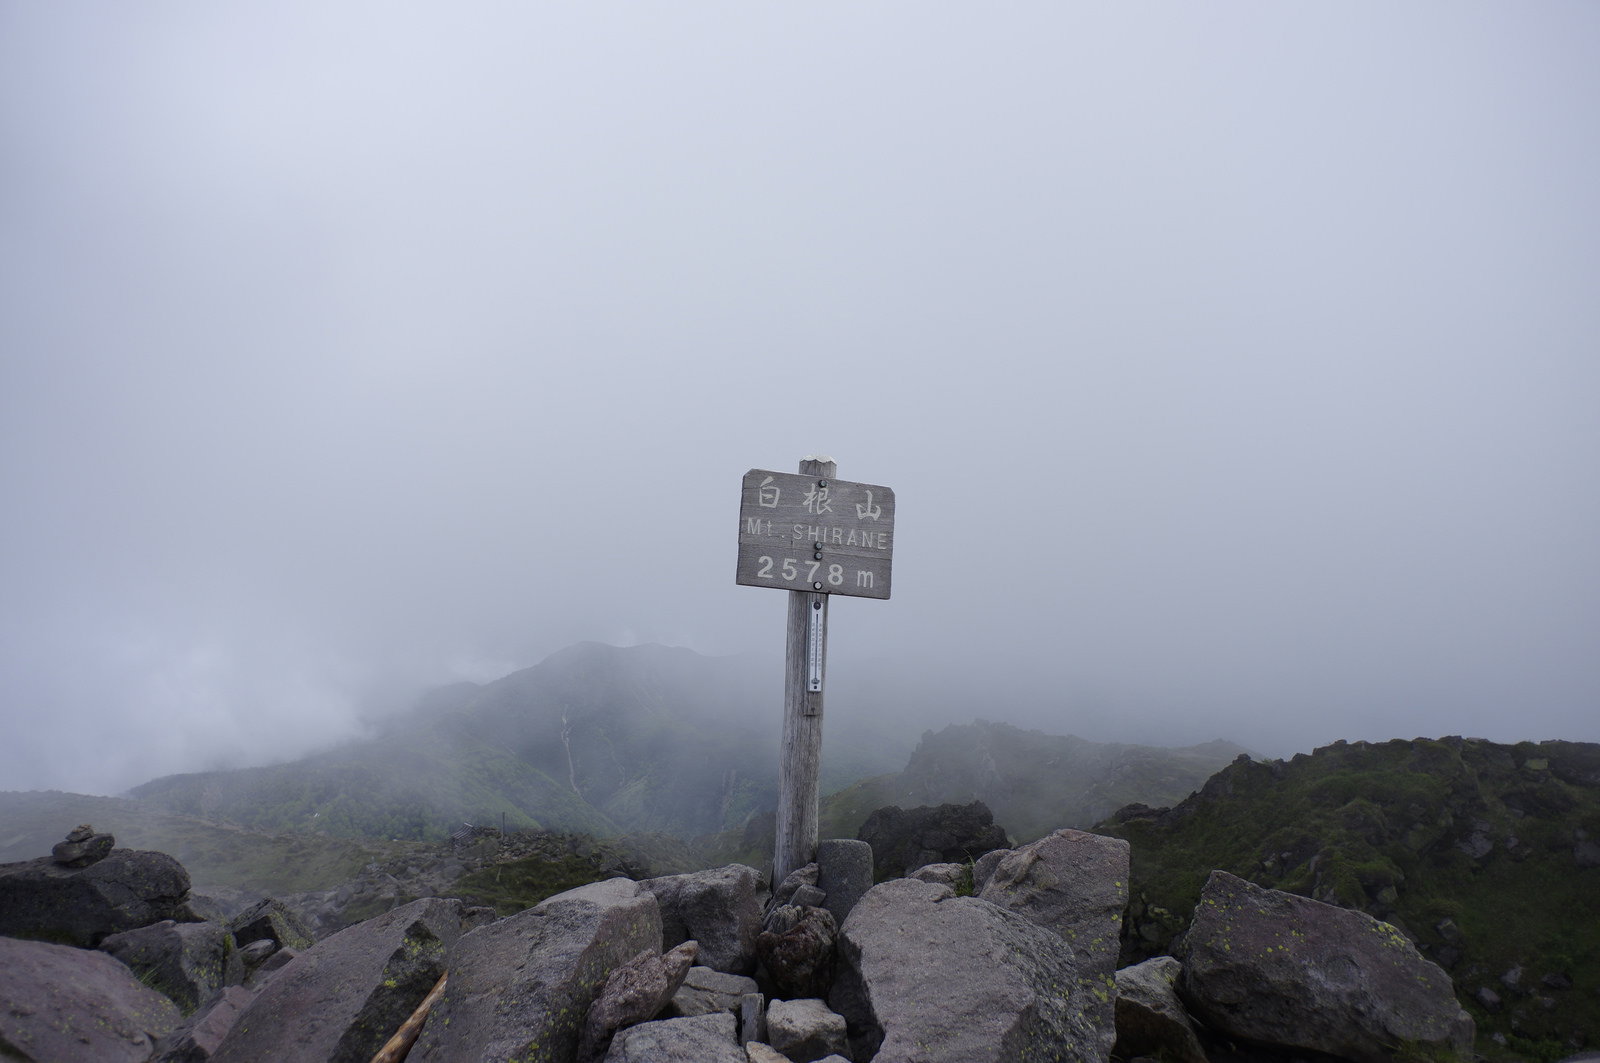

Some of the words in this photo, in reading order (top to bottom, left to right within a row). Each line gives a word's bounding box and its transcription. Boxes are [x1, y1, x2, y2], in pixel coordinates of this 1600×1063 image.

[759, 476, 881, 521] 白根山
[747, 517, 785, 539] Mt.
[793, 524, 887, 550] SHIRANE
[757, 555, 843, 586] 2578
[857, 570, 873, 588] m
